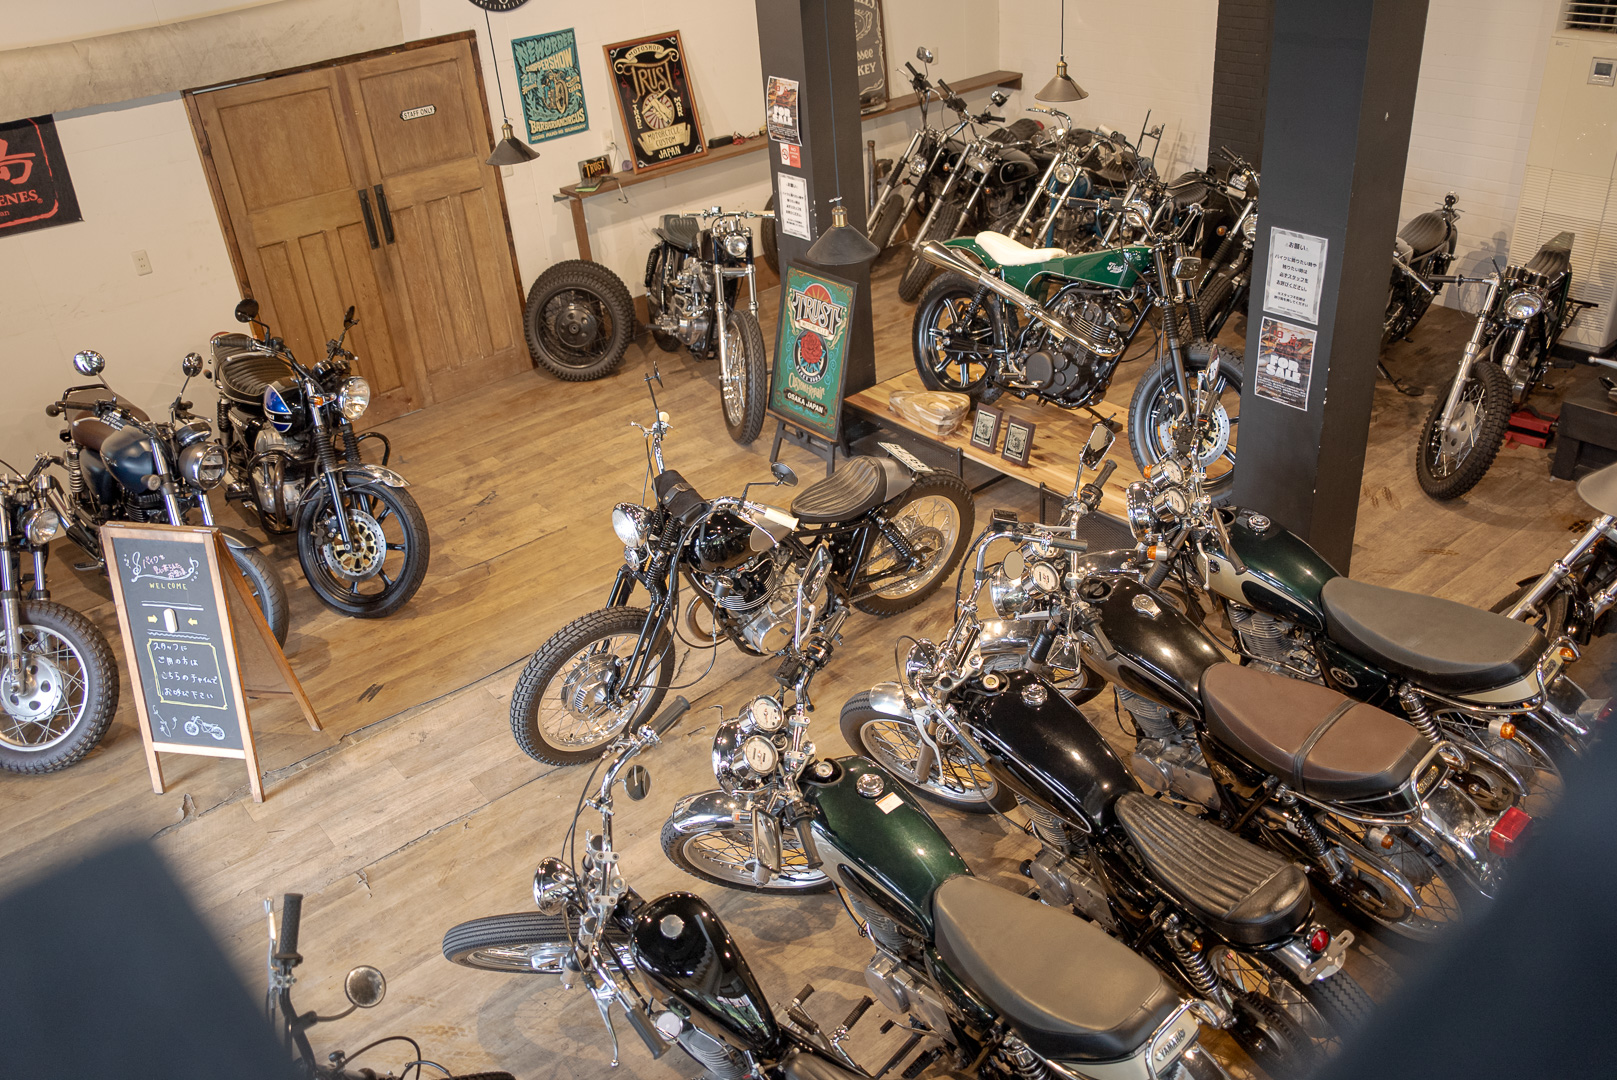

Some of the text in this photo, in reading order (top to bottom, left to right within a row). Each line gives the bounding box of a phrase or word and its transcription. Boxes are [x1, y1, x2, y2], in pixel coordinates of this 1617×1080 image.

[628, 45, 662, 58] MOTOSHOP
[621, 57, 679, 104] TRUST
[403, 107, 434, 119] STAFF ONLY
[773, 104, 791, 118] FOR
[655, 136, 677, 147] CUSTOM
[658, 145, 682, 159] JAPAN
[584, 160, 605, 178] TRUST
[1288, 241, 1306, 251] お願い
[792, 291, 843, 336] TRUST
[1269, 354, 1300, 373] FOR
[1265, 363, 1301, 384] SALE
[787, 392, 825, 414] OSAKA JAPAN
[153, 641, 188, 651] スタッフに
[1160, 1030, 1185, 1057] YAMAHA
